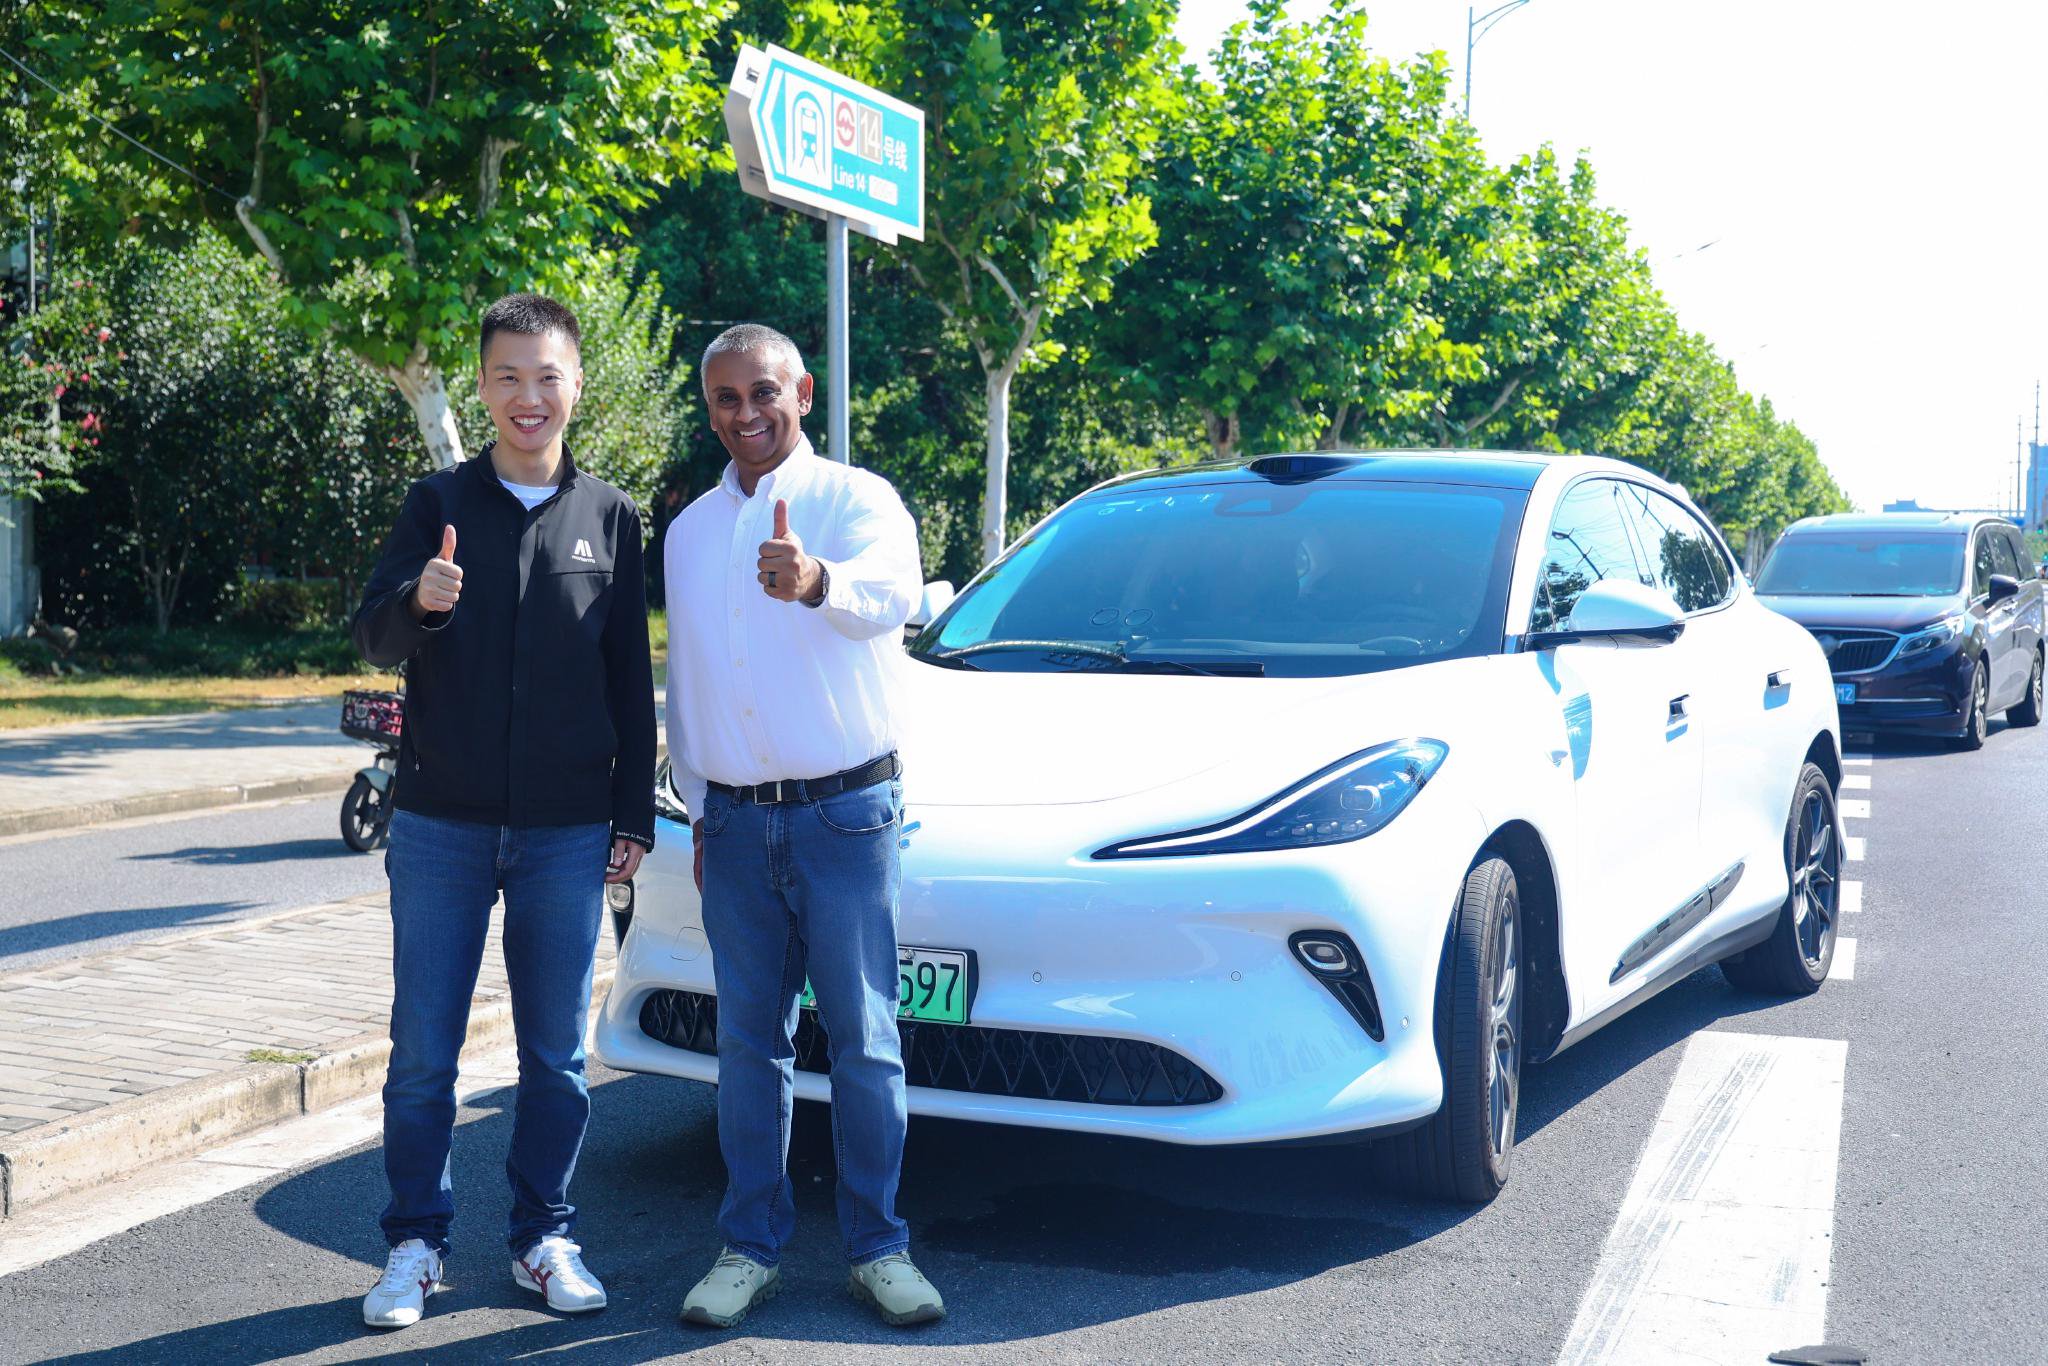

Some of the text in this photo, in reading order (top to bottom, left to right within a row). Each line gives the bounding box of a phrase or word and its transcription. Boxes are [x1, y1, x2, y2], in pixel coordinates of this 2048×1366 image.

[861, 111, 907, 172] 14 号线
[834, 163, 854, 189] Line
[855, 172, 866, 193] 14
